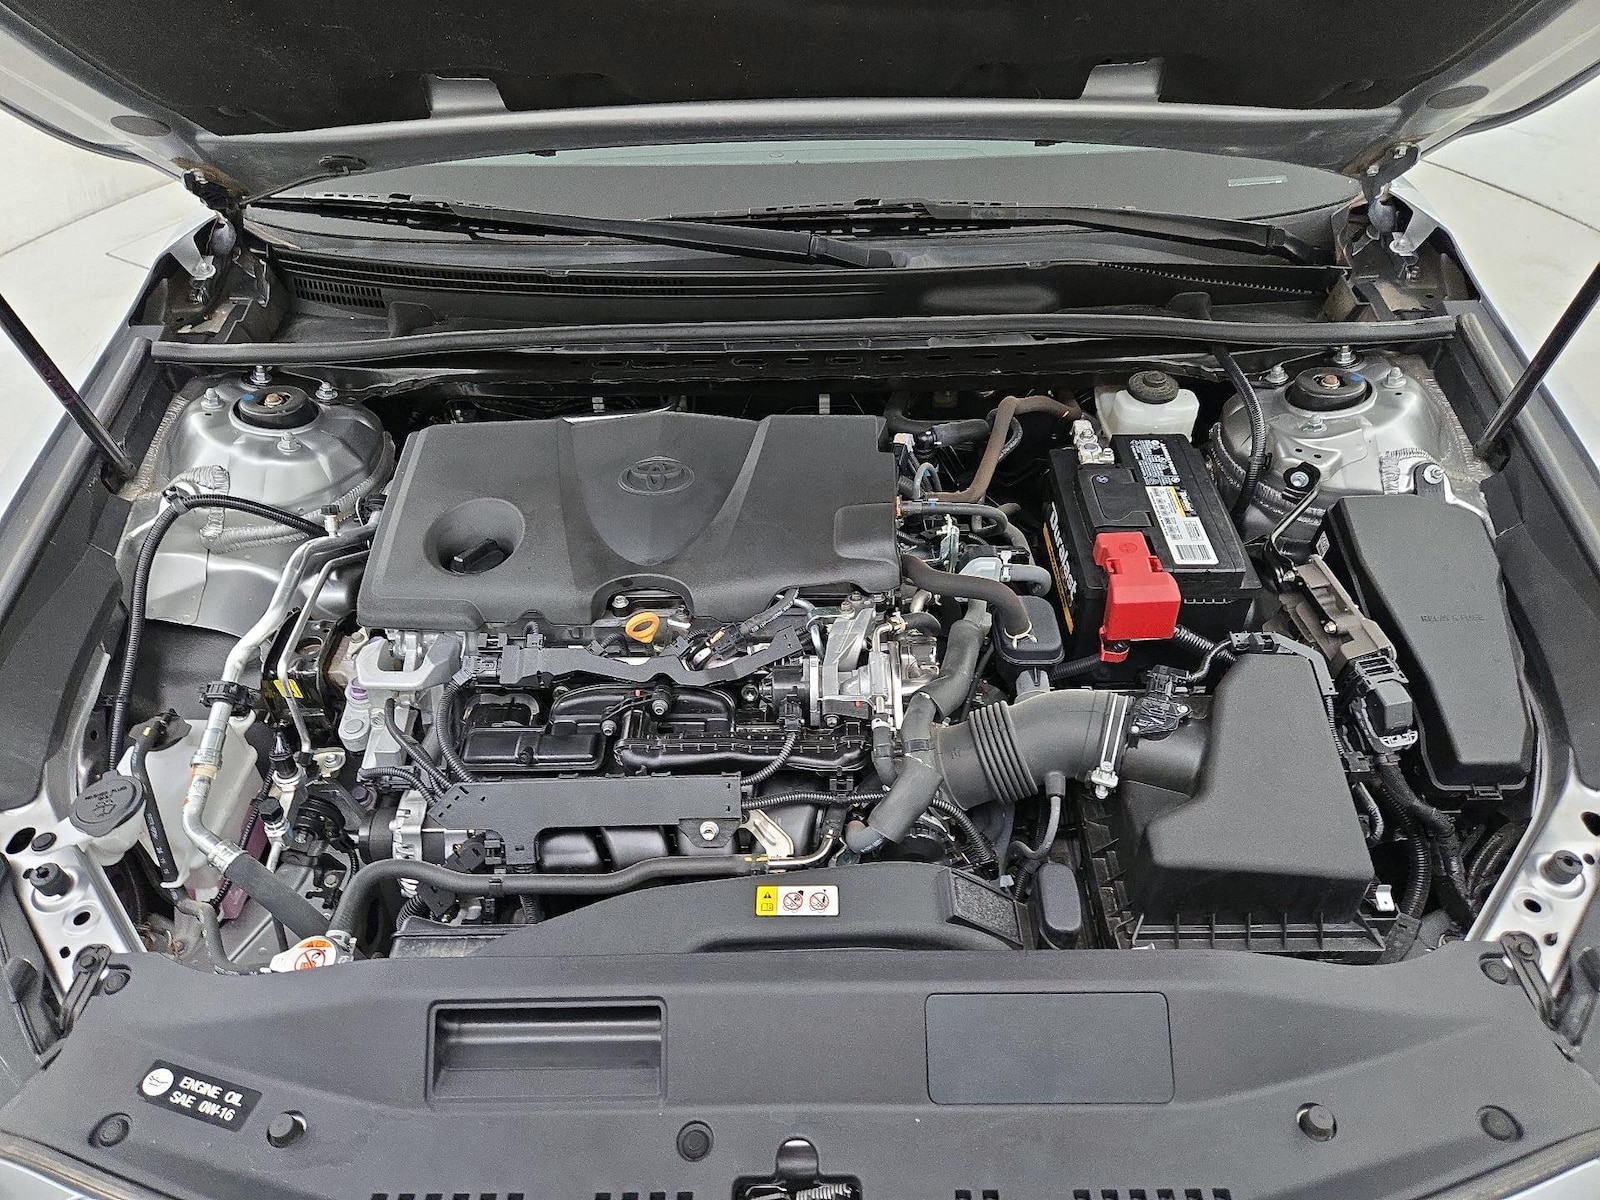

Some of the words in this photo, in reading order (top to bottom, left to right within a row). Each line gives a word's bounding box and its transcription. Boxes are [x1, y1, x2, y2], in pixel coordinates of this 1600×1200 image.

[1049, 501, 1077, 601] Duralast
[169, 1091, 197, 1109] SAE
[198, 1100, 236, 1121] 0W-16
[179, 1076, 223, 1099] ENGINE
[224, 1091, 244, 1107] OIL
